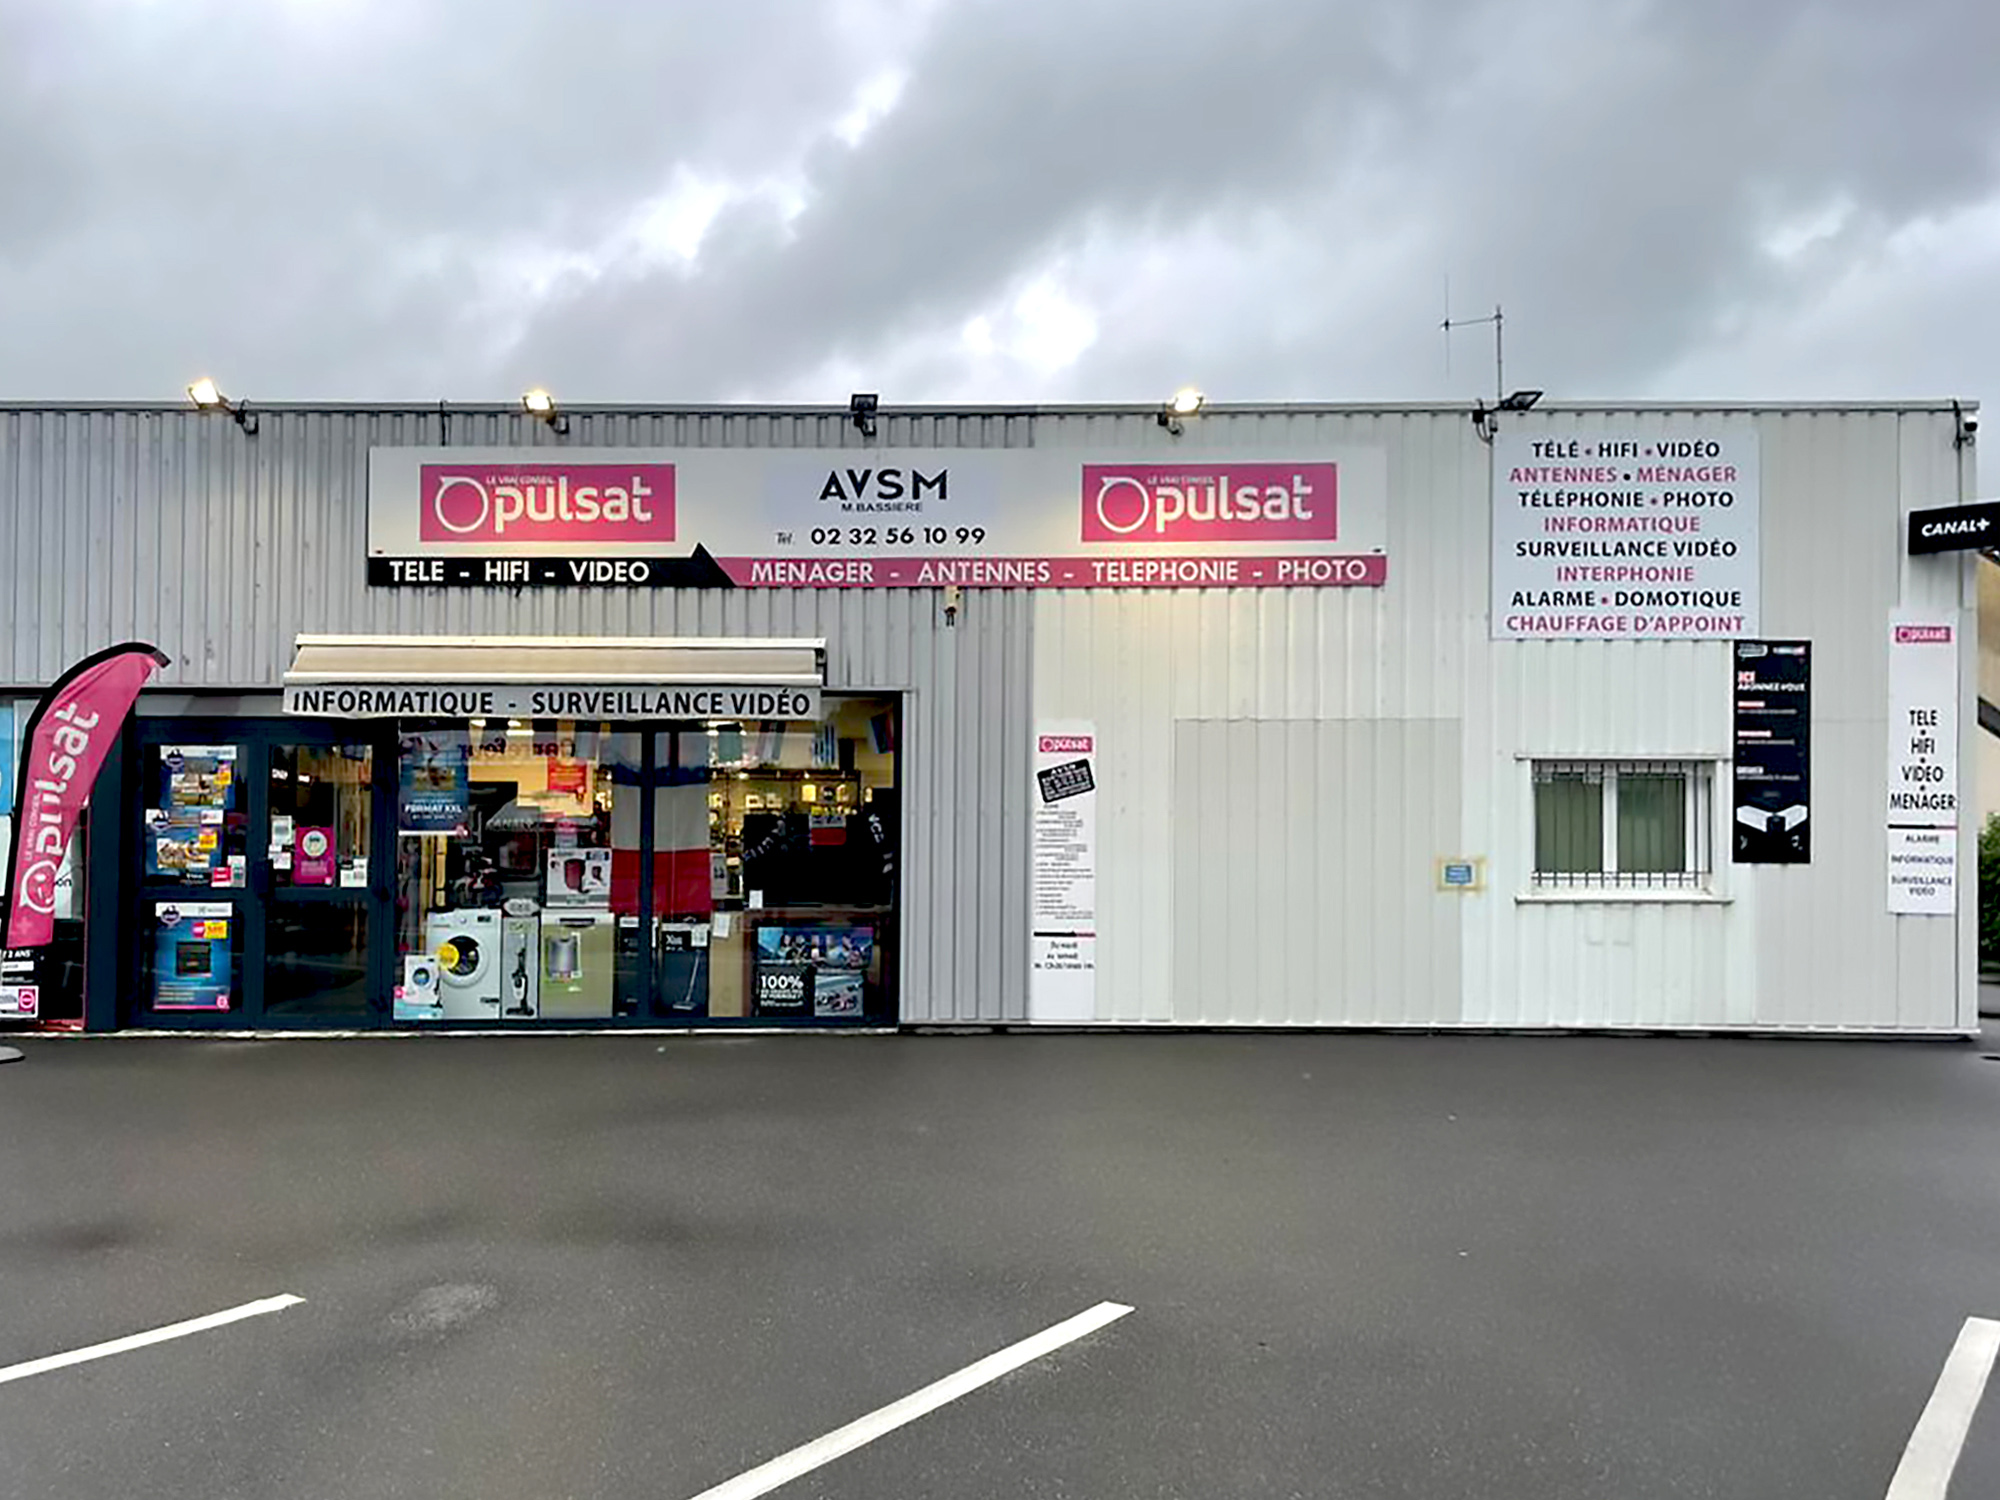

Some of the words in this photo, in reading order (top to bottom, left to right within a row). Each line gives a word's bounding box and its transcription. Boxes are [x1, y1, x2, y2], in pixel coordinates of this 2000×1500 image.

[1532, 439, 1579, 458] TÉLÉ
[1598, 442, 1637, 458] HIFI
[1656, 439, 1720, 458] VIDÉO
[1510, 467, 1617, 483] ANTENNES
[1636, 464, 1736, 483] MÉNAGER
[820, 469, 948, 501] AVSM
[494, 475, 653, 533] pulsat
[1155, 475, 1313, 533] pulsat
[1518, 488, 1644, 508] TÉLÉPHONIE
[1663, 491, 1734, 508] PHOTO
[1544, 517, 1701, 534] INFORMATIQUE
[1921, 517, 1990, 537] CANAL+
[811, 528, 841, 545] 02
[849, 528, 877, 545] 32
[885, 528, 914, 545] 56
[924, 528, 947, 545] 10
[955, 528, 985, 545] 99
[1516, 541, 1668, 557] SURVEILLANCE
[1674, 538, 1737, 557] VIDÉO
[390, 561, 444, 582] TELE
[485, 560, 530, 582] HIFI
[569, 560, 650, 582] VIDEO
[751, 560, 875, 583] MENAGER
[917, 560, 1050, 583] ANTENNES
[1092, 561, 1239, 582] TELEPHONIE
[1278, 559, 1367, 581] PHOTO
[1557, 566, 1695, 582] INTERPHONIE
[1511, 591, 1595, 606] ALARME
[1614, 591, 1741, 608] DOMOTIQUE
[1507, 615, 1627, 632] CHAUFFAGE
[1634, 615, 1744, 632] D'APPOINT
[293, 690, 494, 716] INFORMATIQUE
[532, 691, 723, 715] SURVEILLANCE
[730, 687, 811, 716] VIDÉO
[1910, 710, 1938, 726] TELE
[1911, 738, 1935, 754] HIFI
[34, 701, 99, 857] pulsat
[1902, 766, 1944, 782] VIDEO
[405, 804, 443, 813] FORMAT
[444, 804, 462, 813] XXL
[1890, 793, 1956, 810] MENAGER
[1905, 834, 1940, 843] ALARME
[1891, 855, 1953, 865] INFORMATIQUE
[1891, 876, 1952, 886] SURVEILLANCE
[761, 975, 804, 988] 100%
